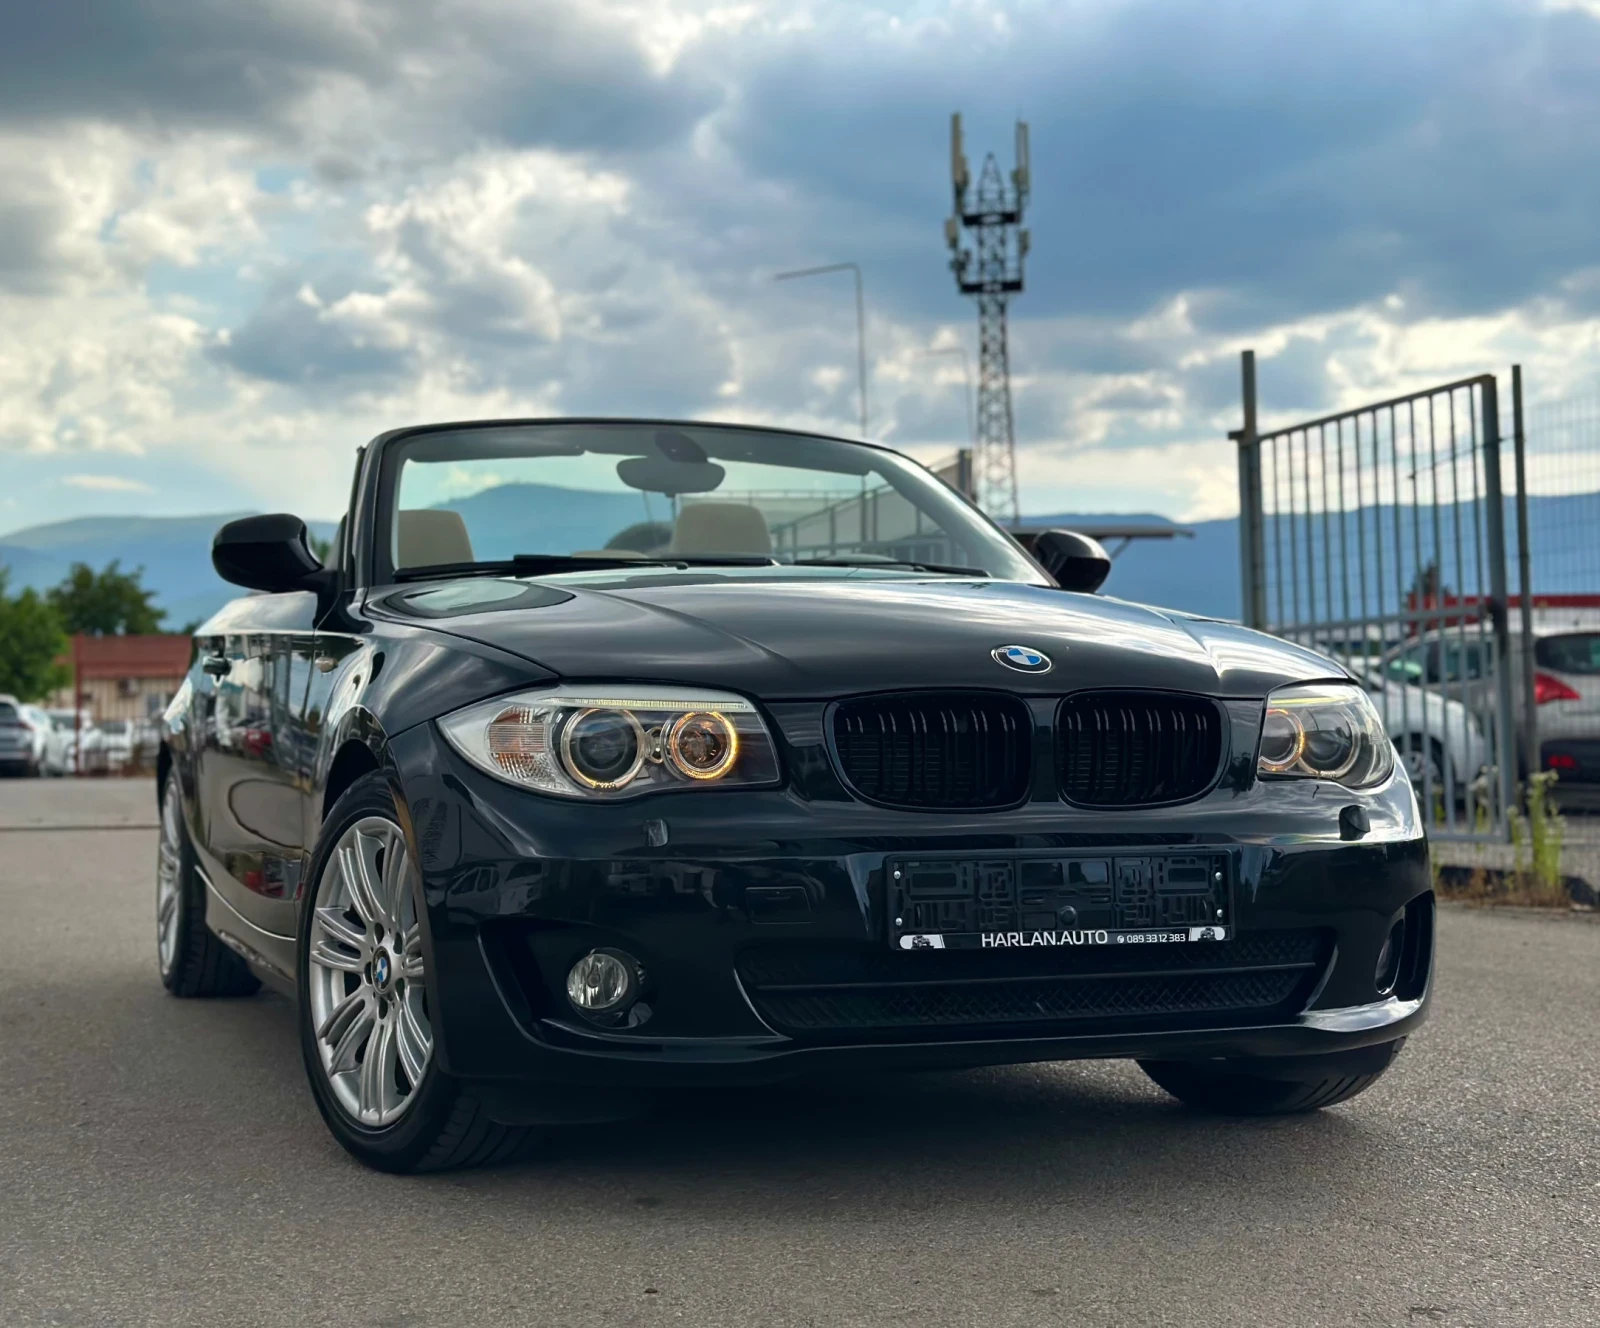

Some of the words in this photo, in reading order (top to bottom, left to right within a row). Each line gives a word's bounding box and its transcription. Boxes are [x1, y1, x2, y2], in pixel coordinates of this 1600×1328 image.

[981, 930, 1108, 947] HARLAN.AUTO
[1126, 934, 1145, 943] 089
[1168, 933, 1186, 942] 383
